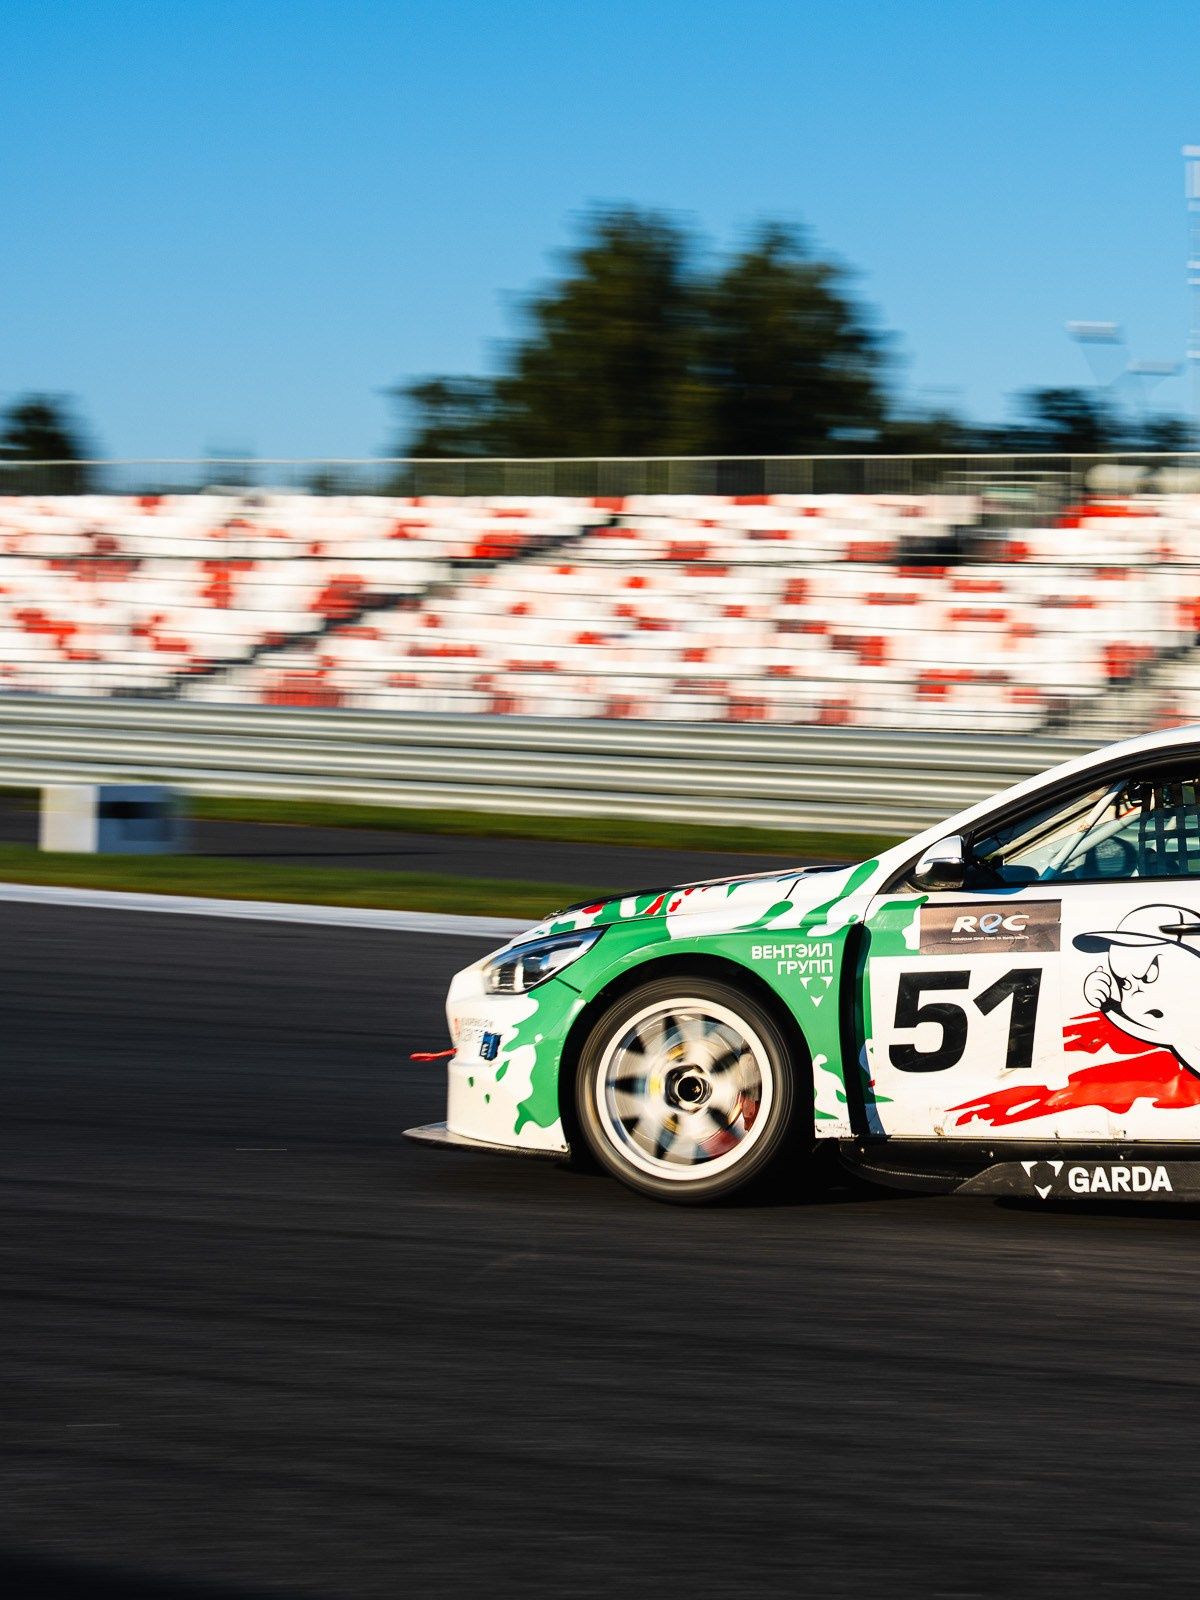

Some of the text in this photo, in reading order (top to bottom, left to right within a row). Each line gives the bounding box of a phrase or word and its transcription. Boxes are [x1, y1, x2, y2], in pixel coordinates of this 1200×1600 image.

[752, 943, 832, 960] ВЕНТЭИЛ
[777, 959, 833, 975] ГРУПП
[889, 968, 1043, 1073] 51
[1068, 1166, 1173, 1193] GARDA
